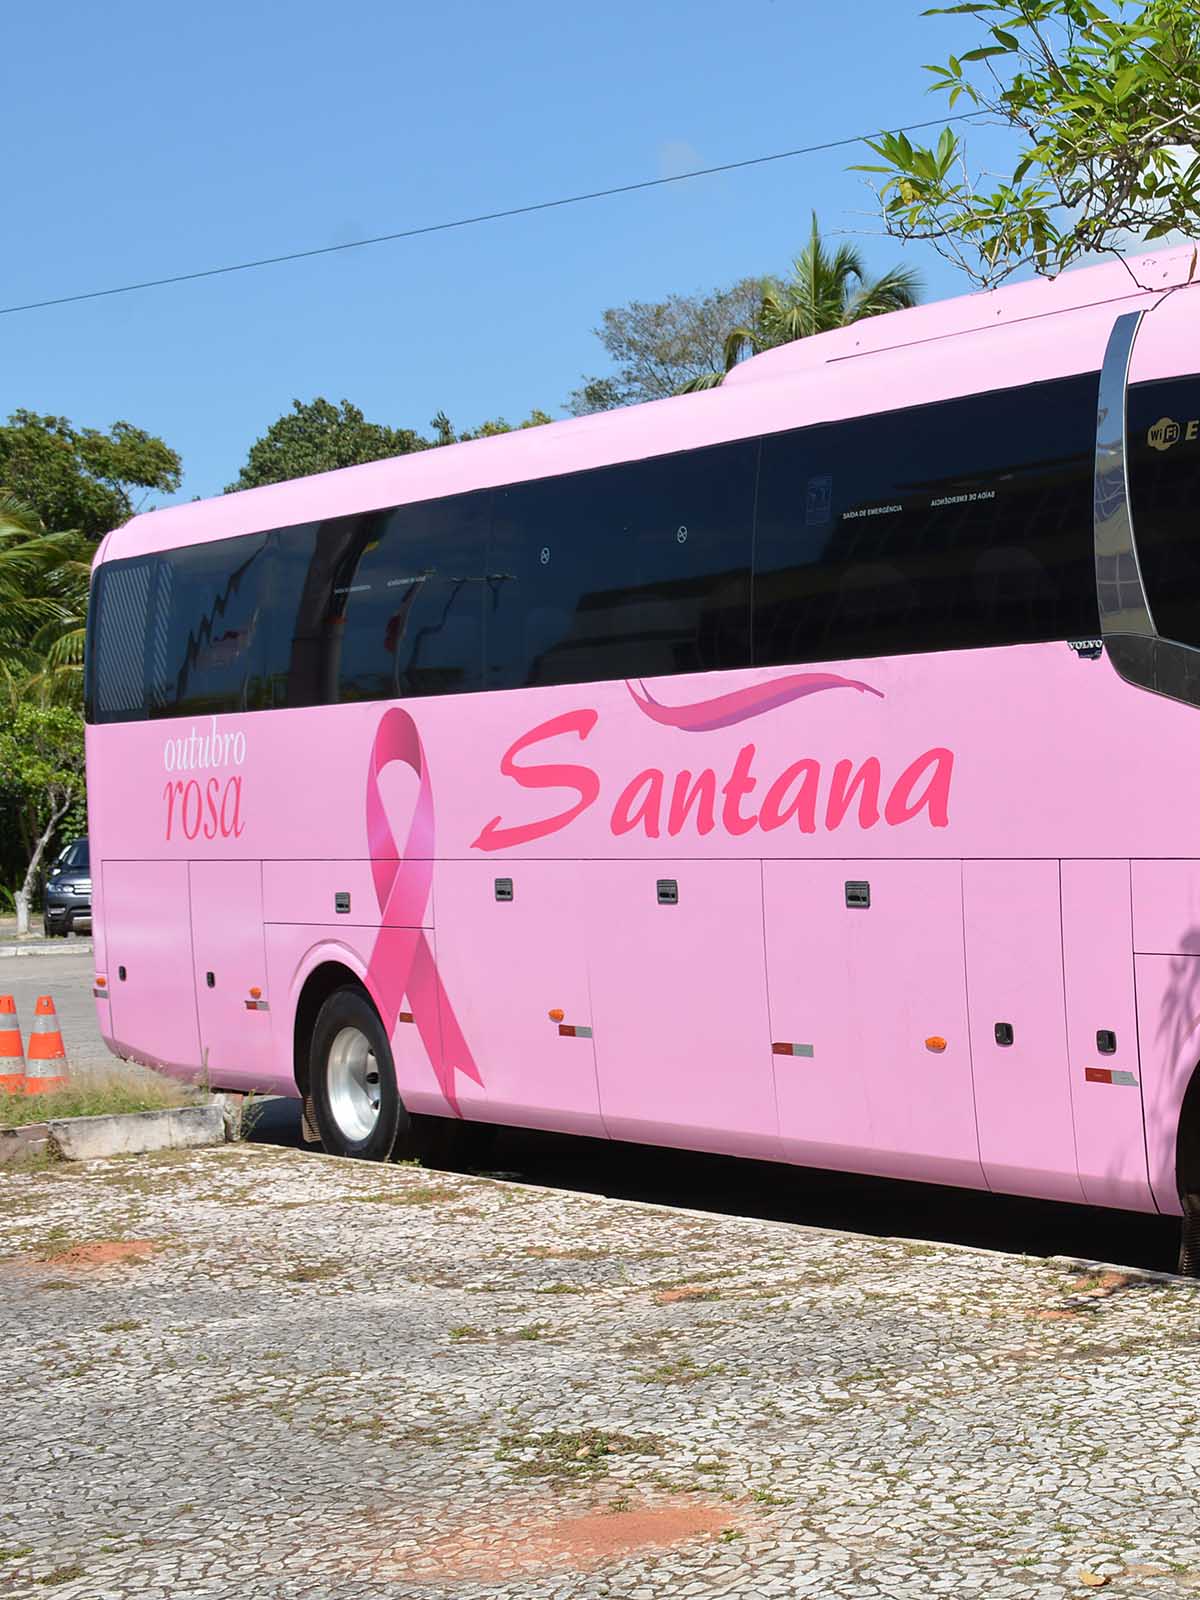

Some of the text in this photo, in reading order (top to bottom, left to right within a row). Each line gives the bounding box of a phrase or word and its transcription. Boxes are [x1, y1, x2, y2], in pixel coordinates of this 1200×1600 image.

[1185, 419, 1200, 440] E
[1067, 639, 1103, 650] VOLVO
[164, 716, 247, 772] outubro
[163, 775, 246, 841] rosa
[469, 708, 955, 852] Santana
